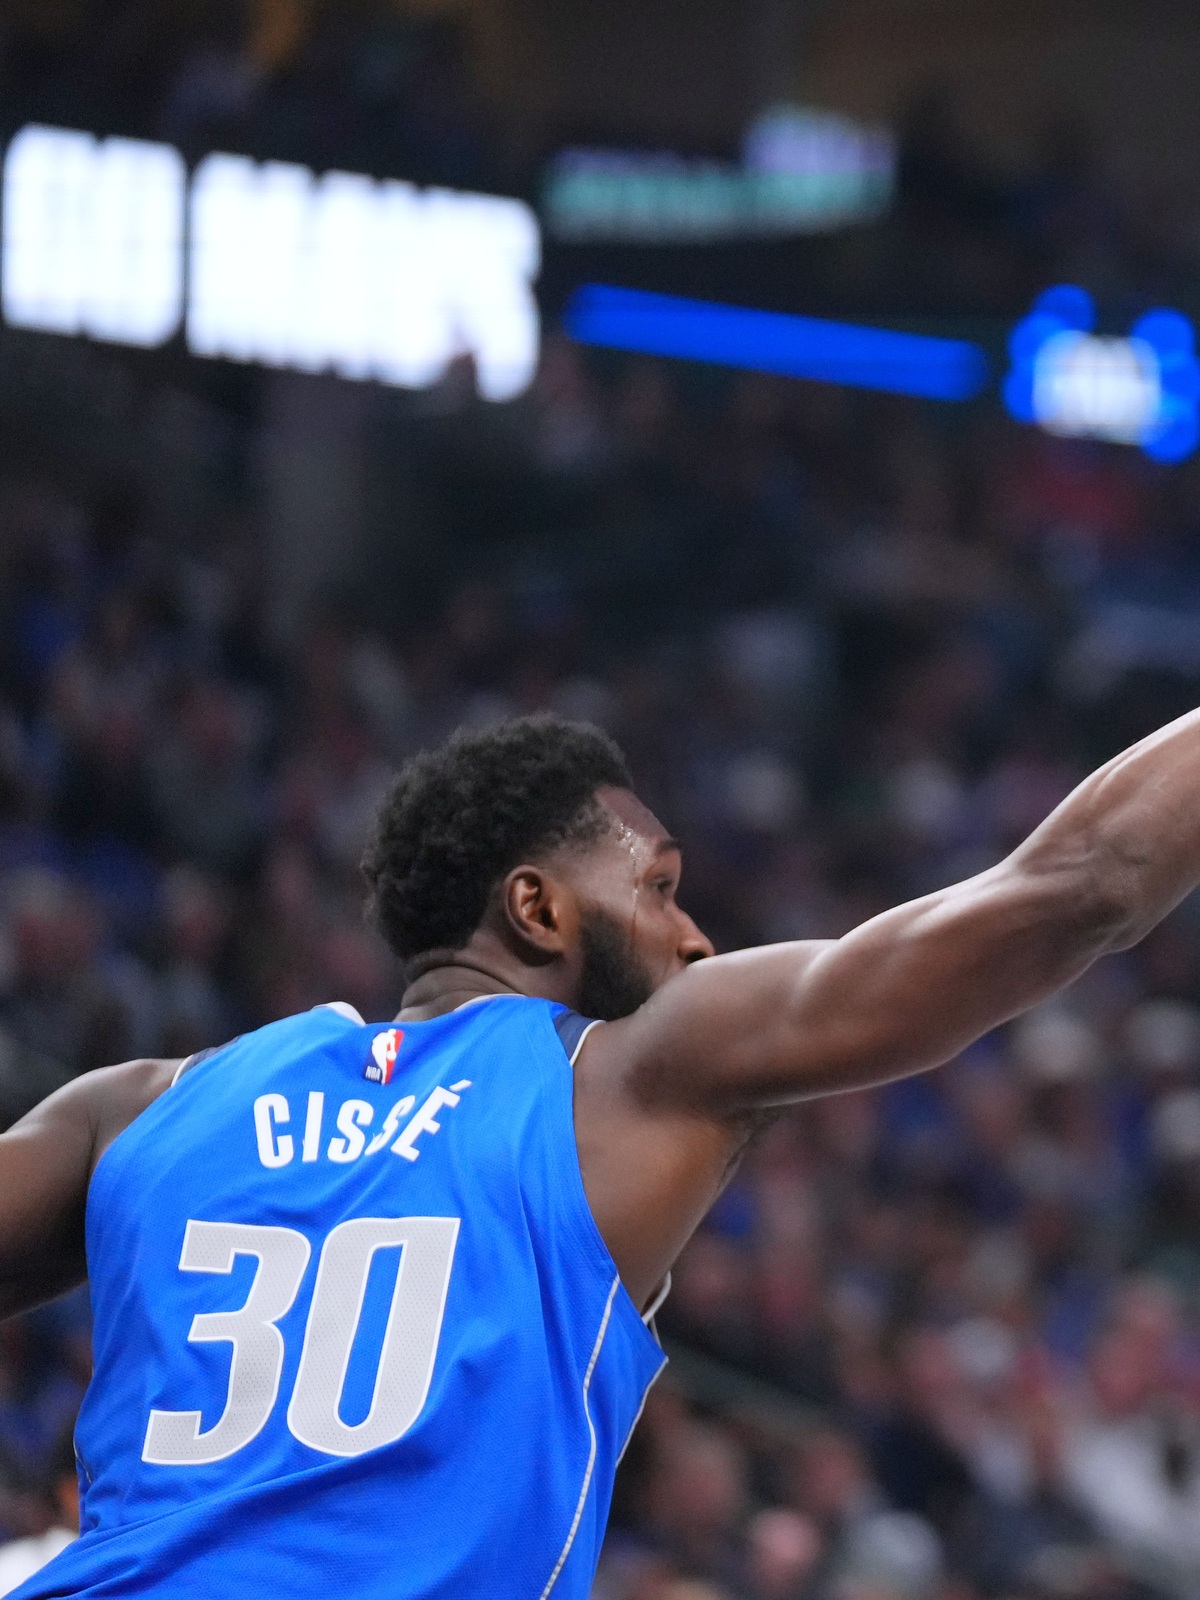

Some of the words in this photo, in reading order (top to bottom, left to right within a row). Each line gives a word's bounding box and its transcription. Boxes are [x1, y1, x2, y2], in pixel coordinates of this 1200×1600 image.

[365, 1065, 381, 1081] NBA
[253, 1079, 472, 1168] CISSÉ
[142, 1217, 461, 1465] 30
